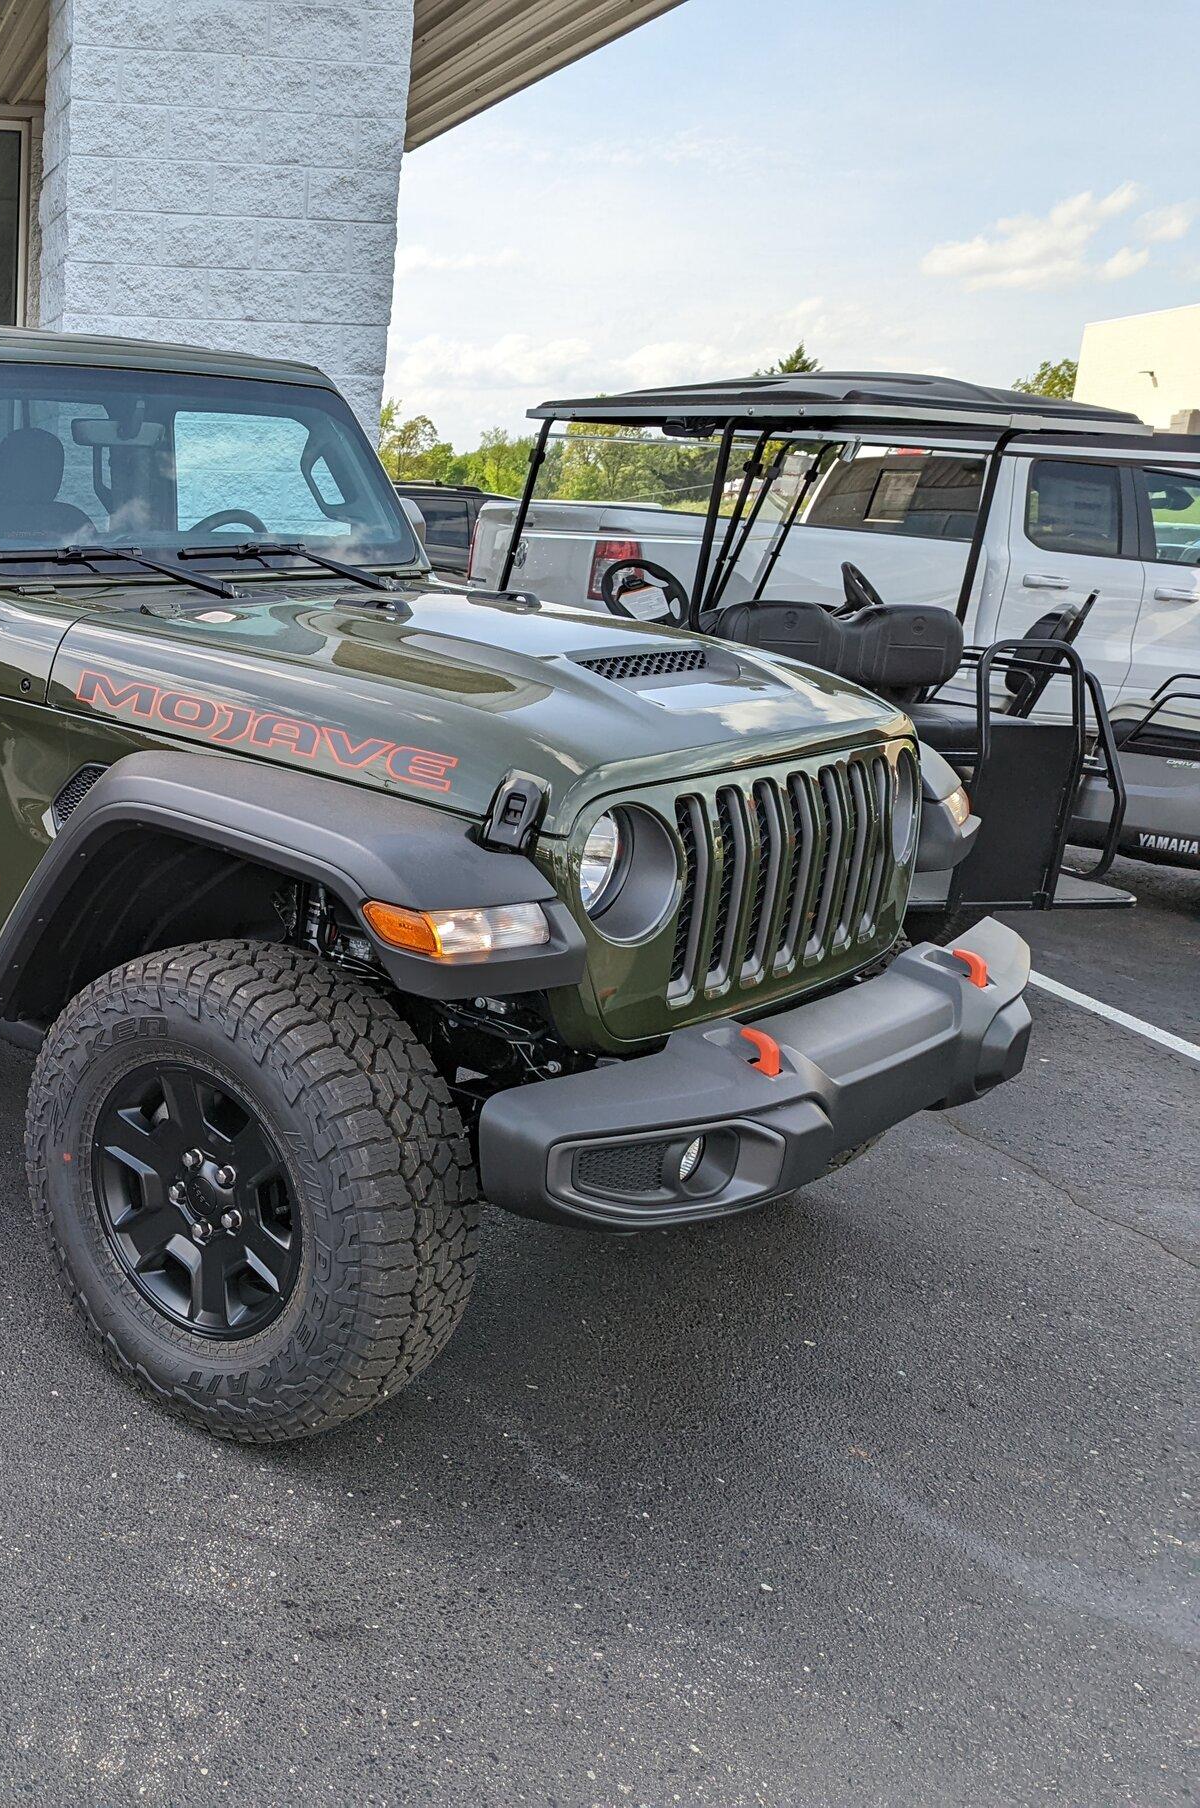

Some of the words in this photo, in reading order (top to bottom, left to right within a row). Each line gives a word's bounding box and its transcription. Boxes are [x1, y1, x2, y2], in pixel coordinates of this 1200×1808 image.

[75, 670, 459, 792] MOJAVE
[1139, 833, 1199, 855] YAMAHA
[257, 1130, 332, 1391] WILDPEAK
